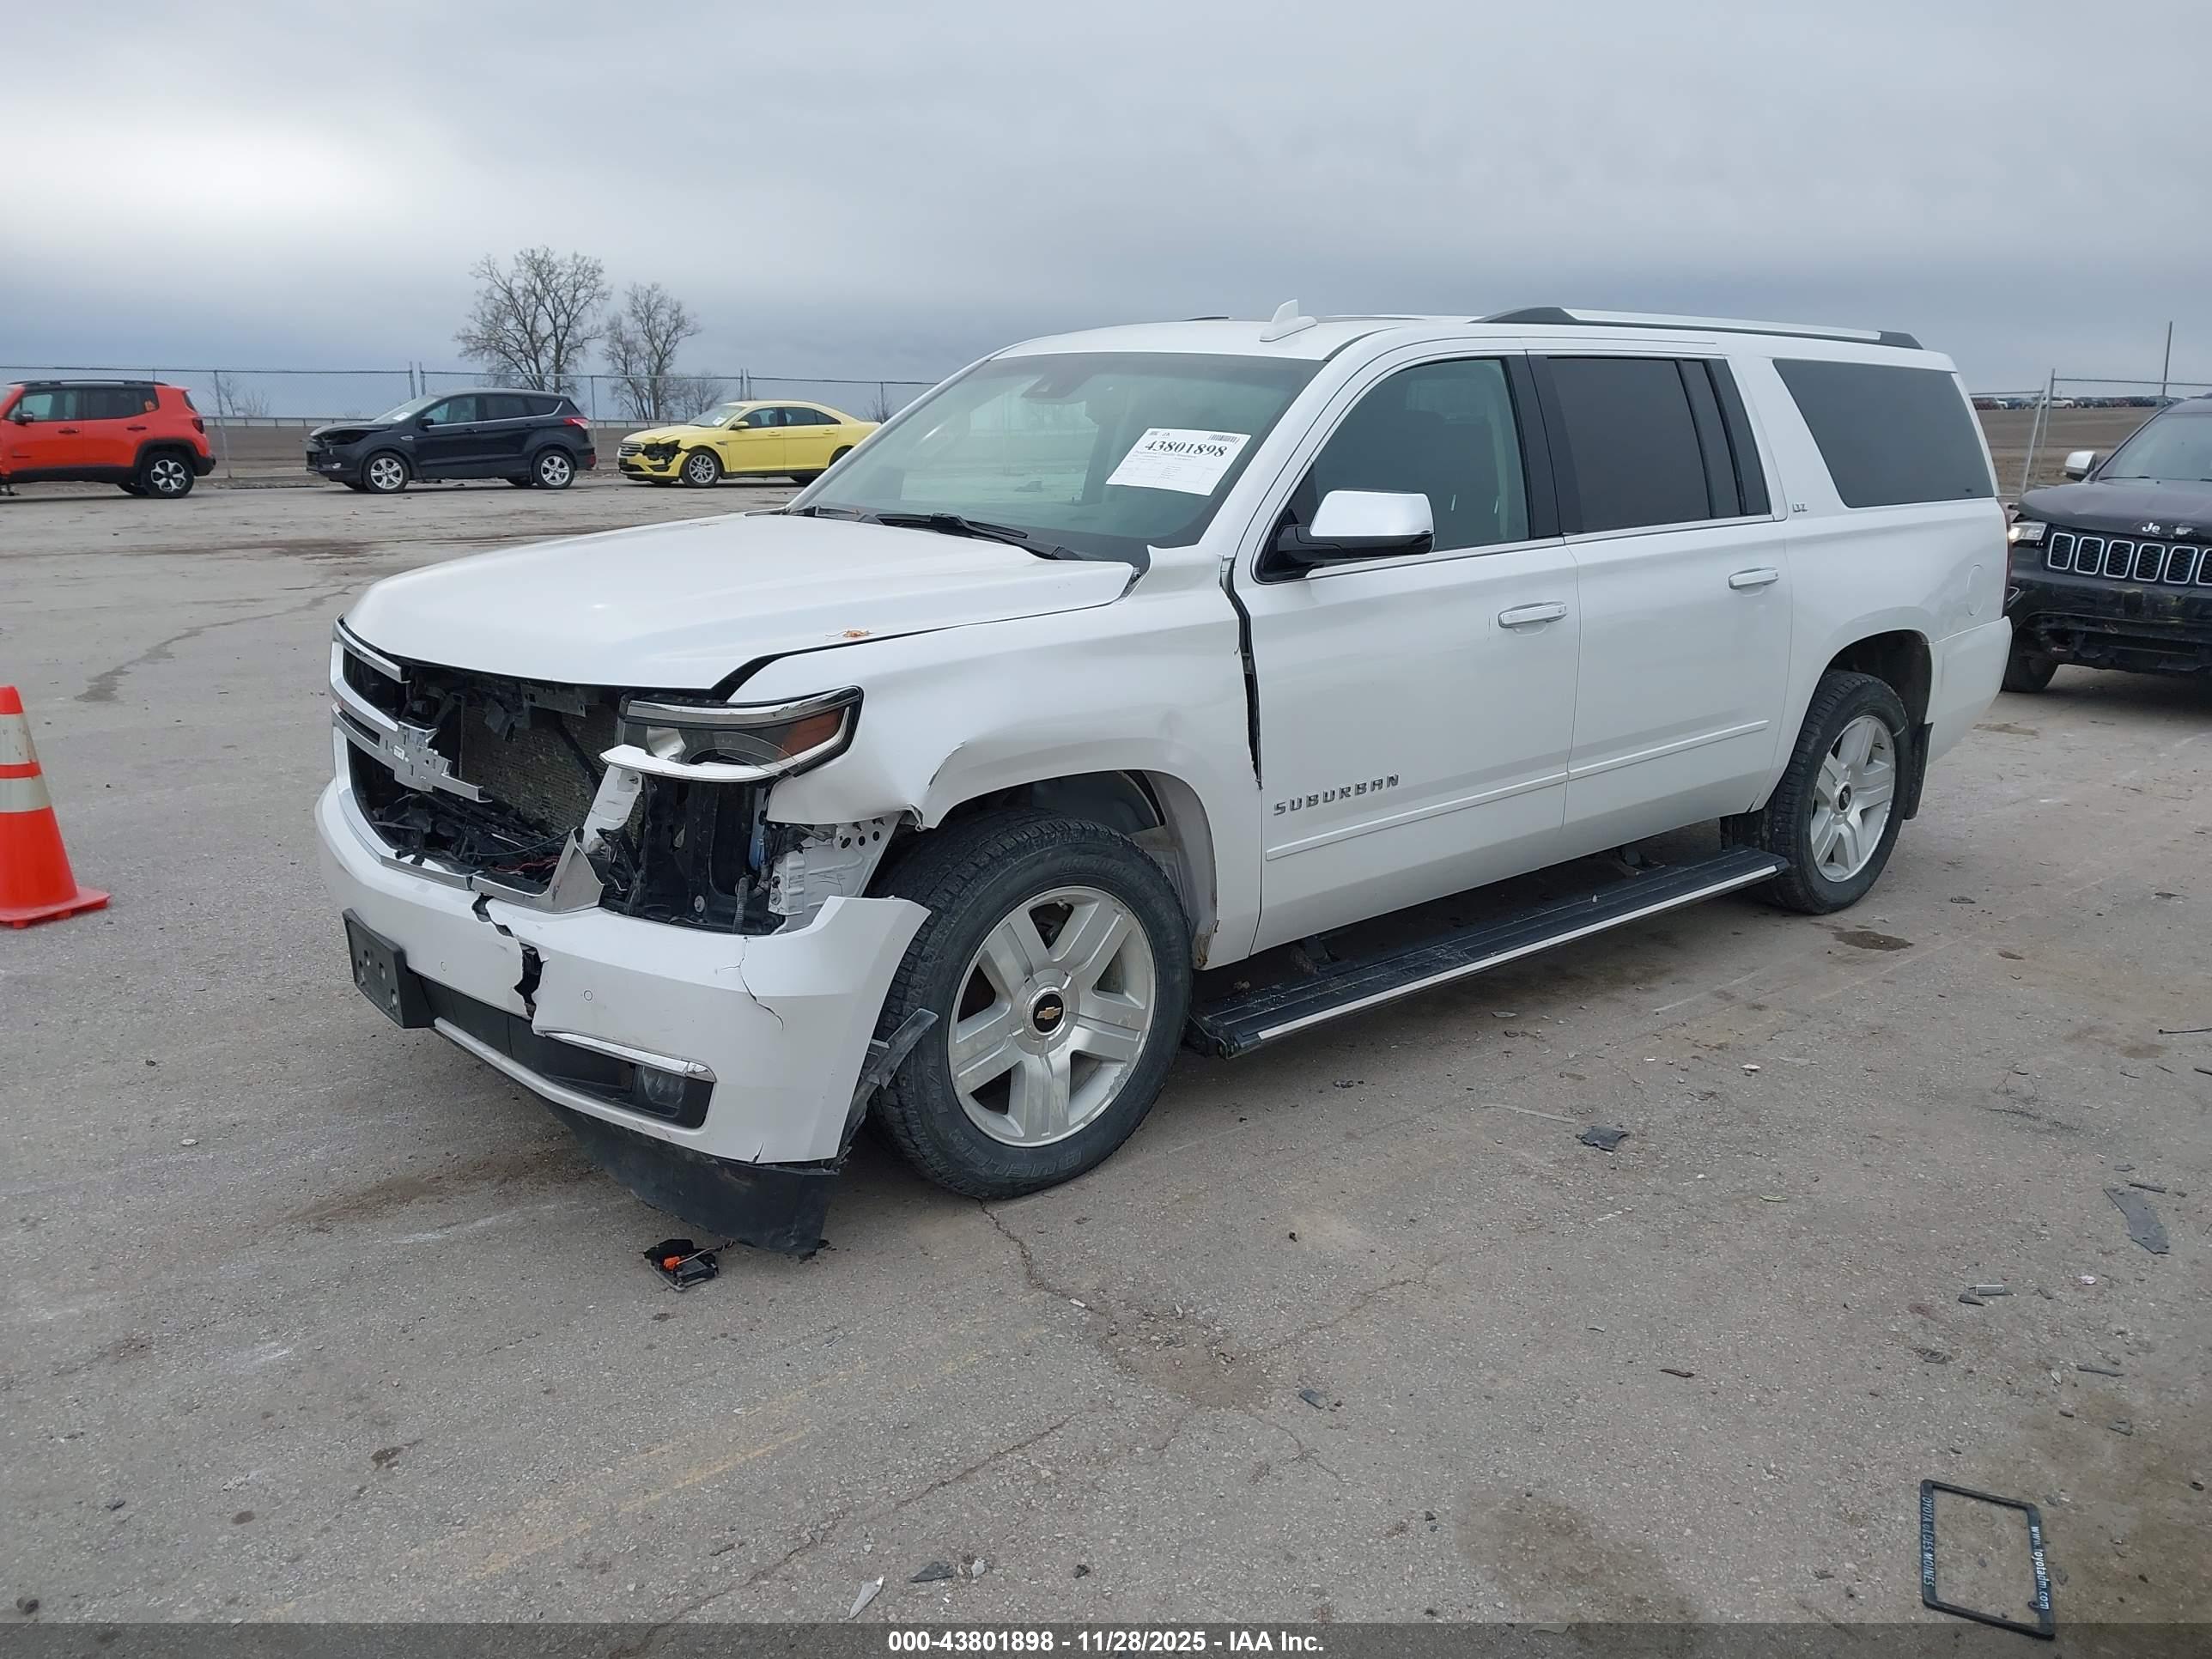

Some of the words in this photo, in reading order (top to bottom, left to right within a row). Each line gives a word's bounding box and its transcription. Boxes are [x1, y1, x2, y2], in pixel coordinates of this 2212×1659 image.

[1145, 440, 1228, 458] 43801898
[1273, 773, 1400, 817] SUBURBAN
[1922, 1495, 1933, 1522] OYOTA
[1923, 1534, 1934, 1551] DES
[1923, 1552, 1936, 1588] MOINES
[2031, 1526, 2051, 1610] www.toyotadm.com
